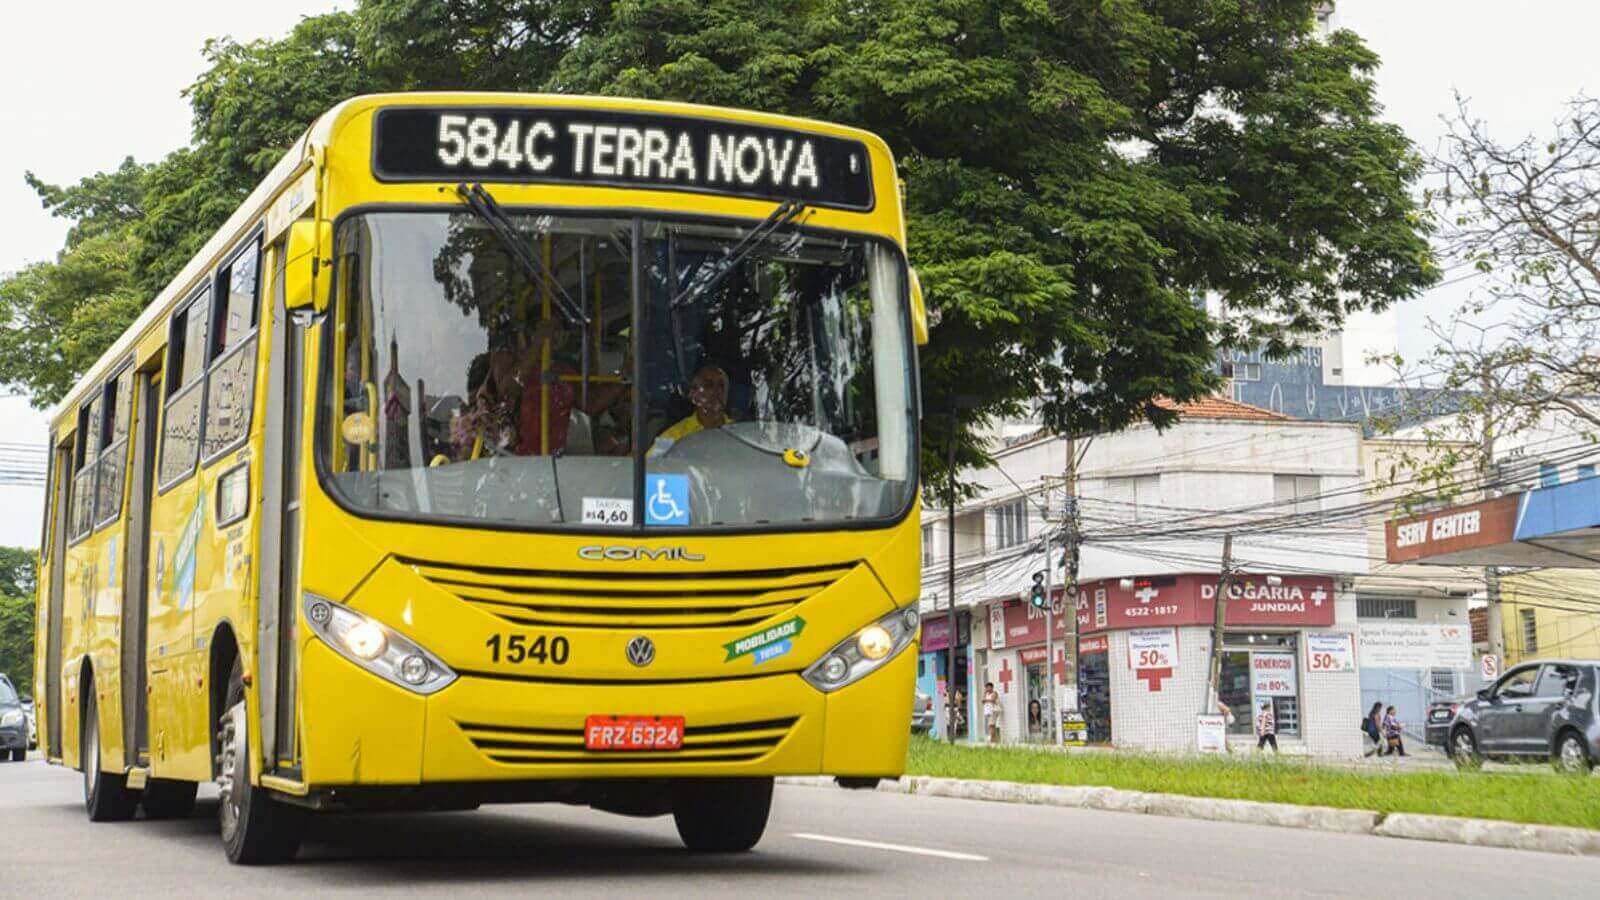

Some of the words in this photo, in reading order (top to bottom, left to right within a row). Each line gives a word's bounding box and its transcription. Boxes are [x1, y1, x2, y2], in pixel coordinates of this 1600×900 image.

[438, 115, 555, 171] 584C
[568, 124, 697, 181] TERRA
[708, 133, 819, 188] NOVA
[1397, 520, 1429, 548] SERV
[1432, 510, 1481, 541] CENTER
[577, 543, 706, 562] COMIL
[1200, 583, 1304, 601] DOGARIA
[734, 620, 798, 655] MOBILIDADE
[486, 634, 570, 665] 1540
[1139, 649, 1169, 666] 50%
[1312, 653, 1340, 669] 50%
[589, 726, 625, 745] FRZ
[632, 725, 679, 745] 6324
